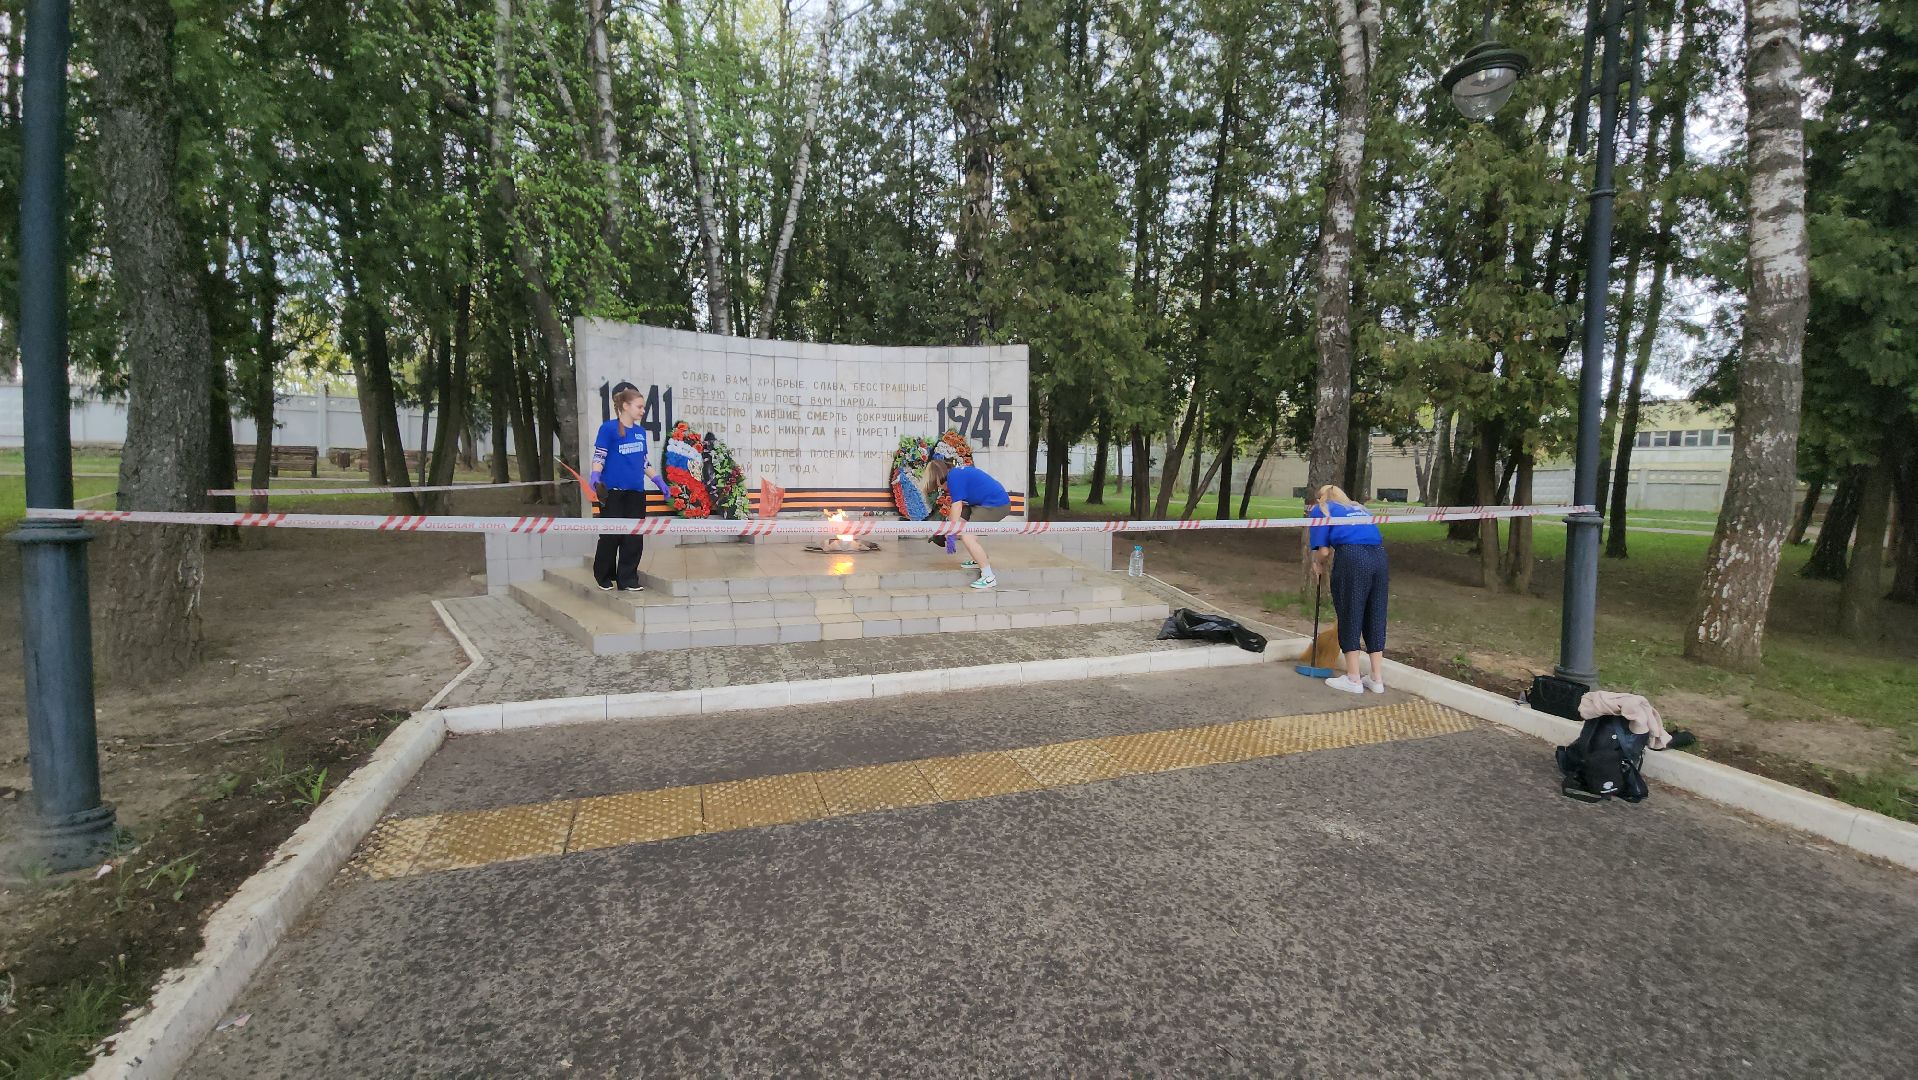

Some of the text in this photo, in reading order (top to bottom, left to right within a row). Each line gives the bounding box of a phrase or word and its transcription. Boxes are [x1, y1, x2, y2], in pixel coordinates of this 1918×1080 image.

[936, 396, 1013, 447] 1945
[552, 523, 628, 531] ОПАСНАЯ ЗОНА
[669, 525, 712, 533] ОПАСНАЯ
